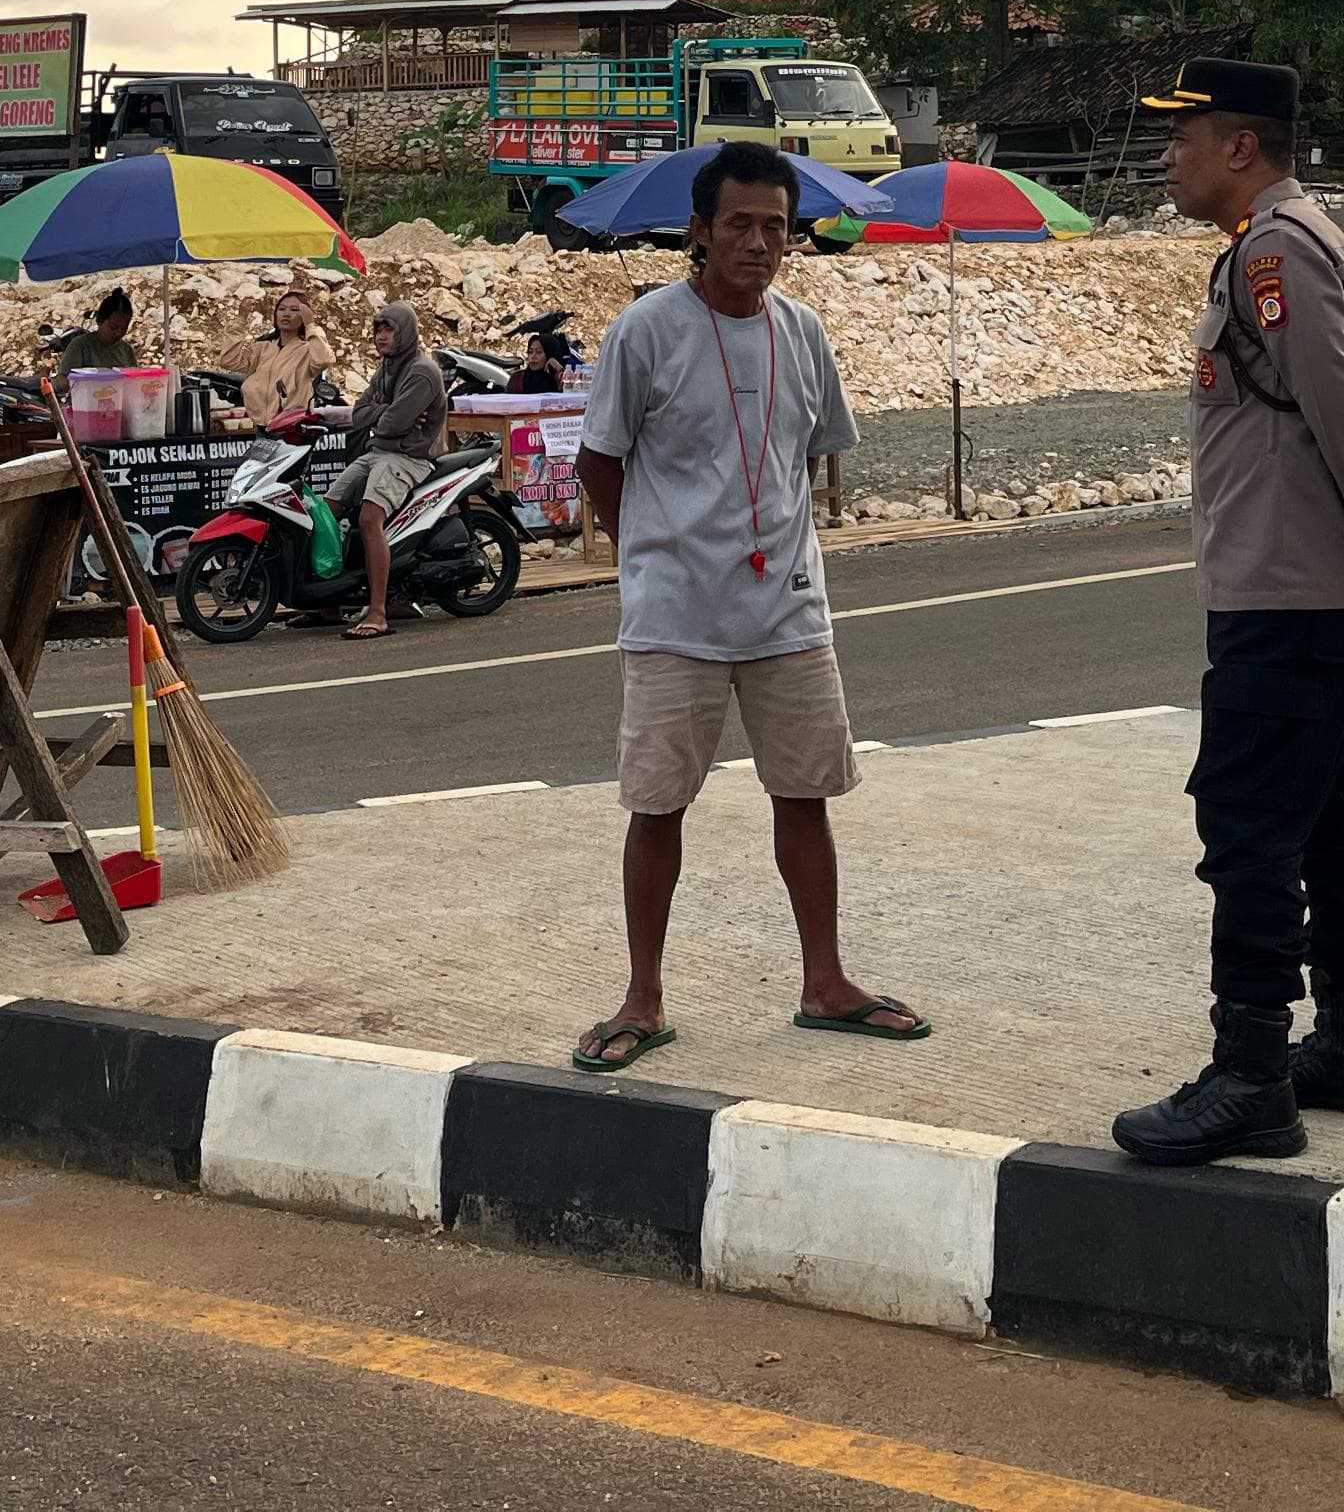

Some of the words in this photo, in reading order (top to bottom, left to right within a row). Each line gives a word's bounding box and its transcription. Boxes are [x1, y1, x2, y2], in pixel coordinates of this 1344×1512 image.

[23, 29, 70, 53] KREMES
[12, 63, 41, 90] LELE
[0, 99, 55, 127] GORENG
[531, 145, 557, 159] eliver
[109, 447, 157, 466] POJOK
[160, 444, 206, 462] SENJA
[141, 474, 149, 482] ES
[553, 464, 574, 480] HOT
[522, 485, 548, 501] KOPI
[556, 483, 577, 500] SUSU
[142, 507, 150, 515] ES
